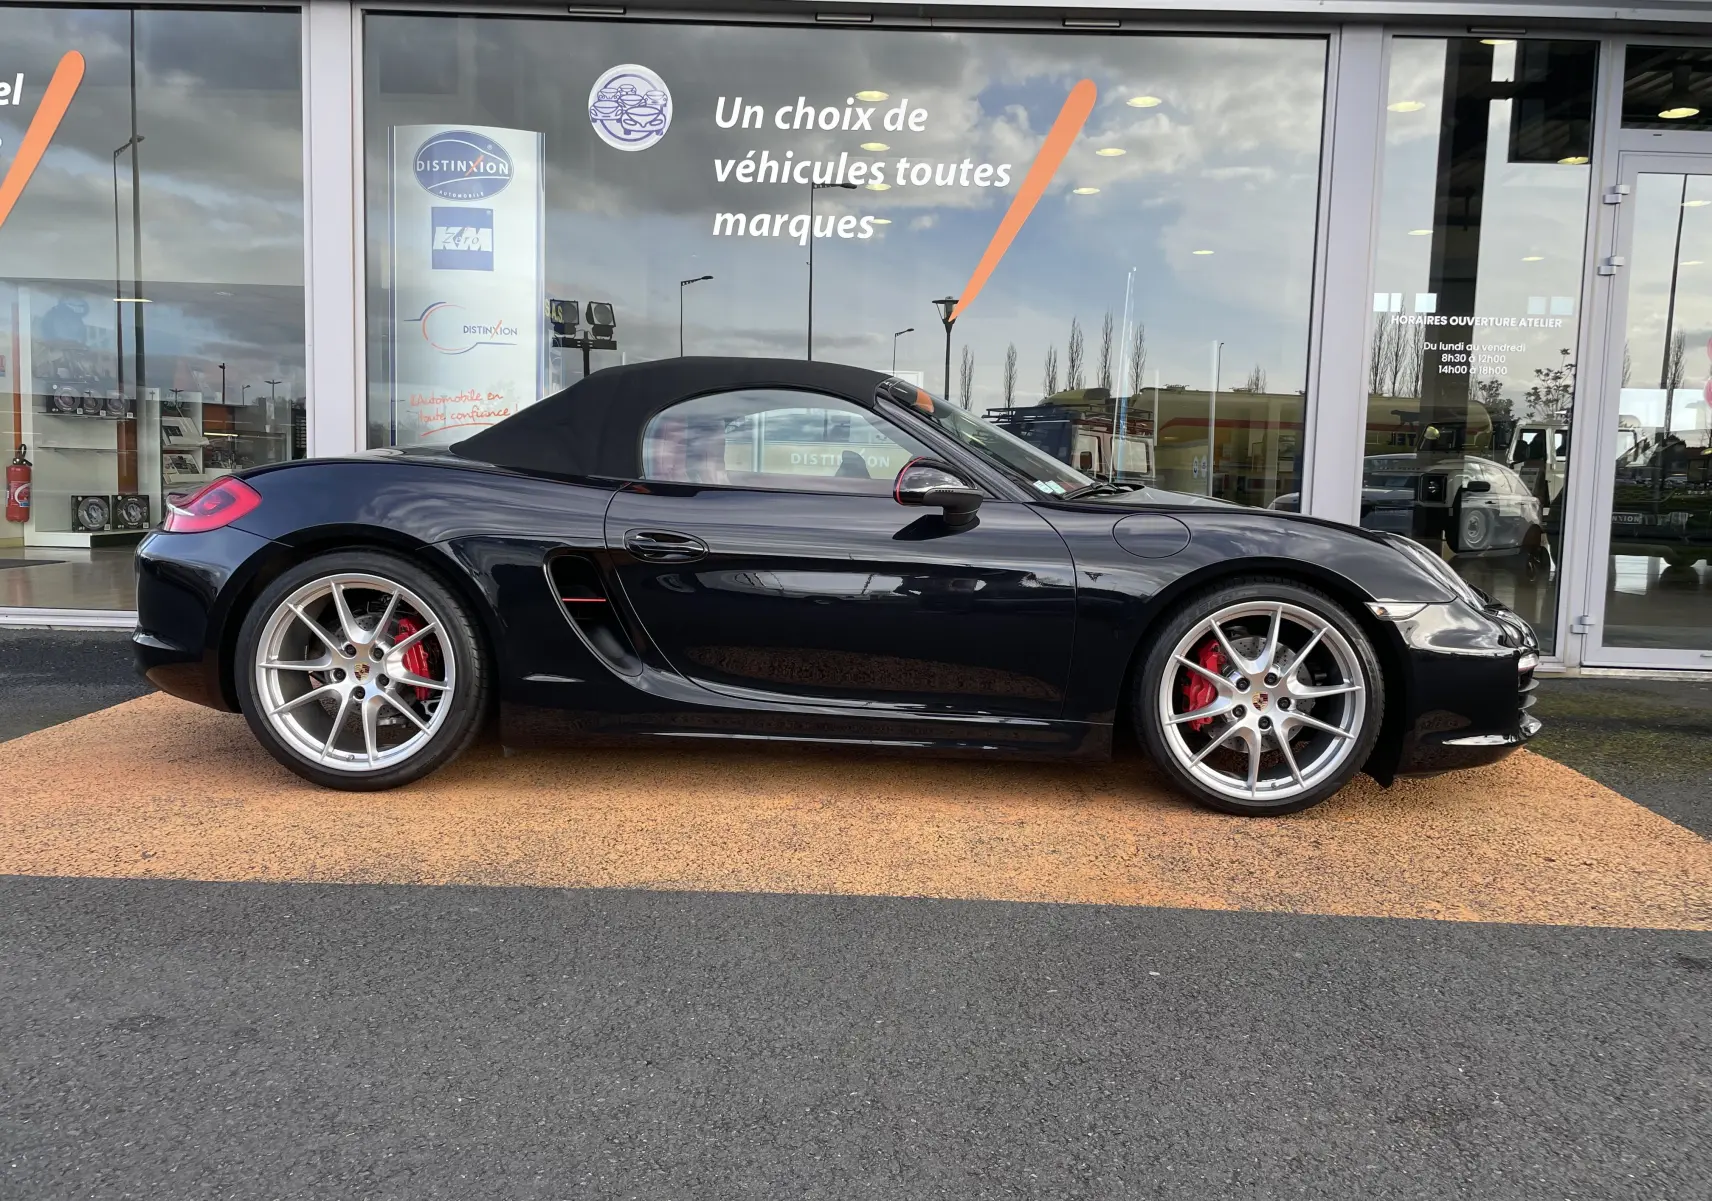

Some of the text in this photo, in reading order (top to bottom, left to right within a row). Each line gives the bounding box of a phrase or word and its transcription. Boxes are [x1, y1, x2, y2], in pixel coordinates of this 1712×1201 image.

[715, 96, 929, 132] Un choix de
[416, 158, 509, 175] DISTINXION
[714, 150, 1012, 188] véhicules toutes
[439, 190, 485, 199] AUTOMOBILE
[712, 212, 875, 246] marques
[1391, 315, 1563, 328] HORAIRES OUVERTURE ATELIER
[463, 323, 518, 337] DISTINXION
[1423, 341, 1526, 352] Du lundi au vendredi
[1441, 353, 1467, 363] 8h30
[1478, 354, 1506, 363] 12h00
[1438, 364, 1468, 374] 14h00
[1479, 366, 1508, 375] 18h00
[487, 392, 504, 401] en
[450, 405, 511, 422] confiance
[790, 450, 890, 468] DISTION
